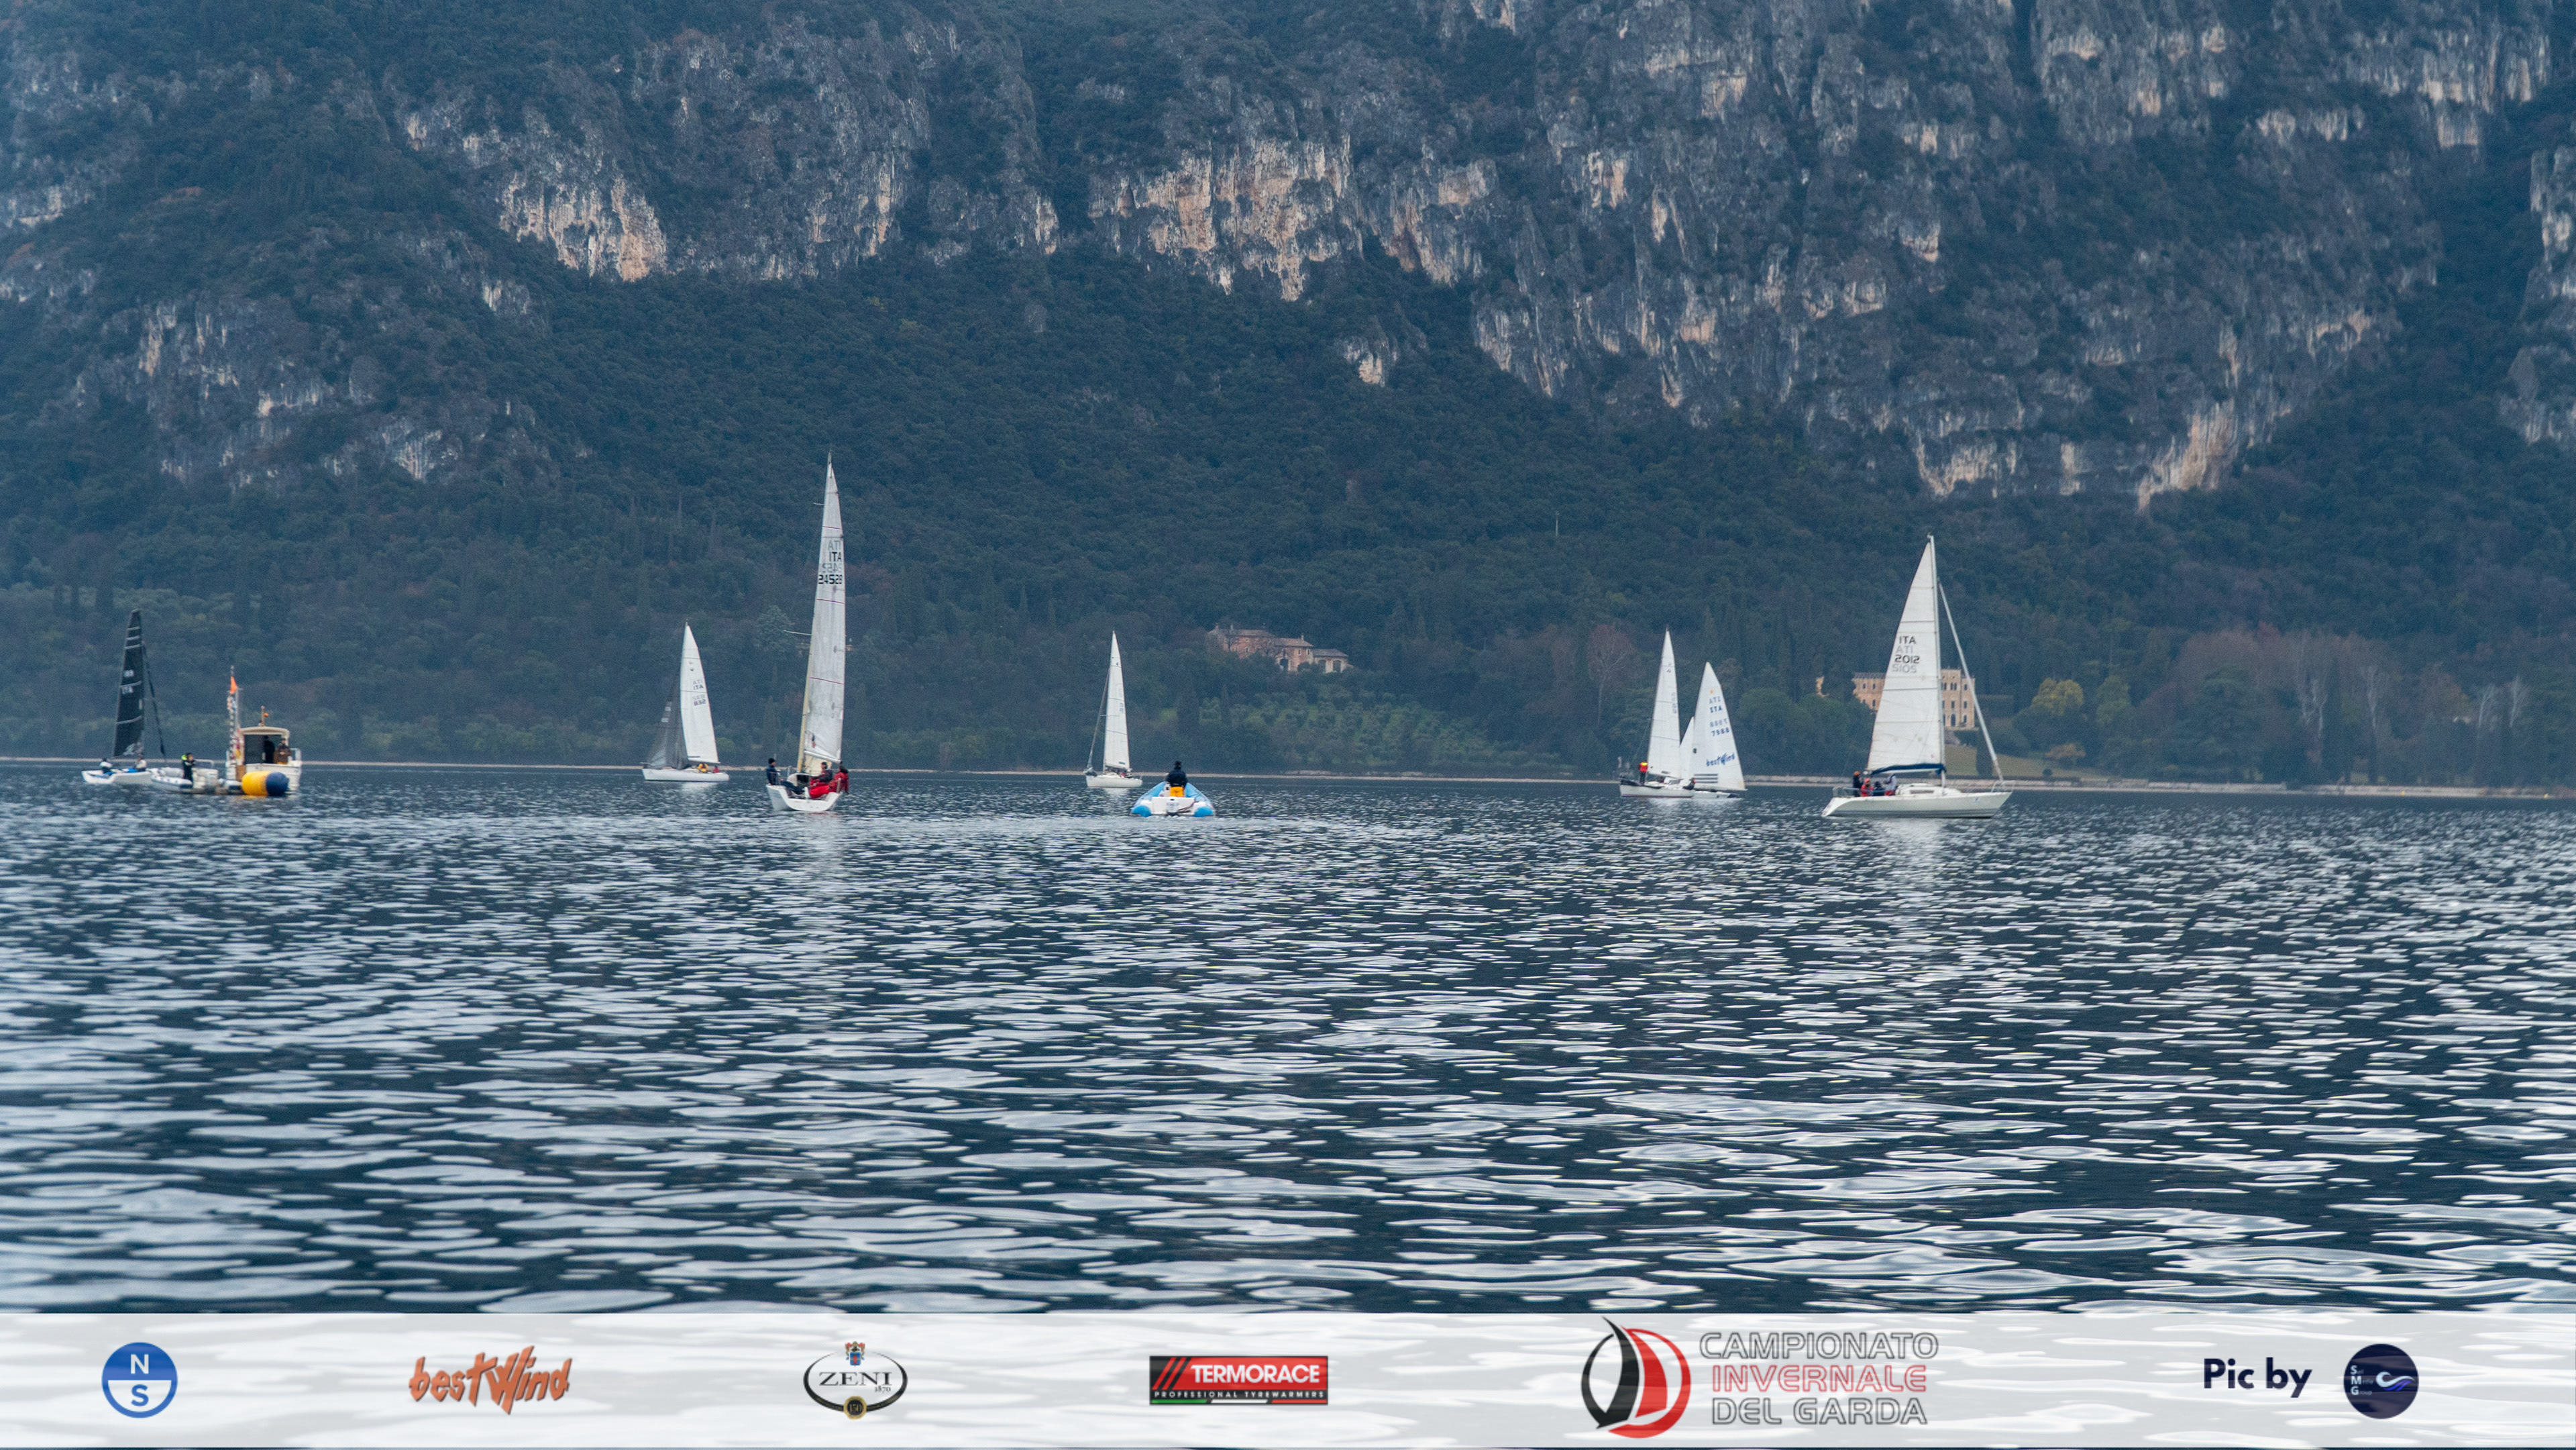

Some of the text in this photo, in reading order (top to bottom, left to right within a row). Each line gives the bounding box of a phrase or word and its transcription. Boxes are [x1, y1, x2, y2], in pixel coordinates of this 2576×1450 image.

[829, 552, 842, 562] ITA
[1899, 635, 1917, 644] ITA
[1894, 654, 1920, 664] 2012
[1710, 705, 1723, 713] ITA
